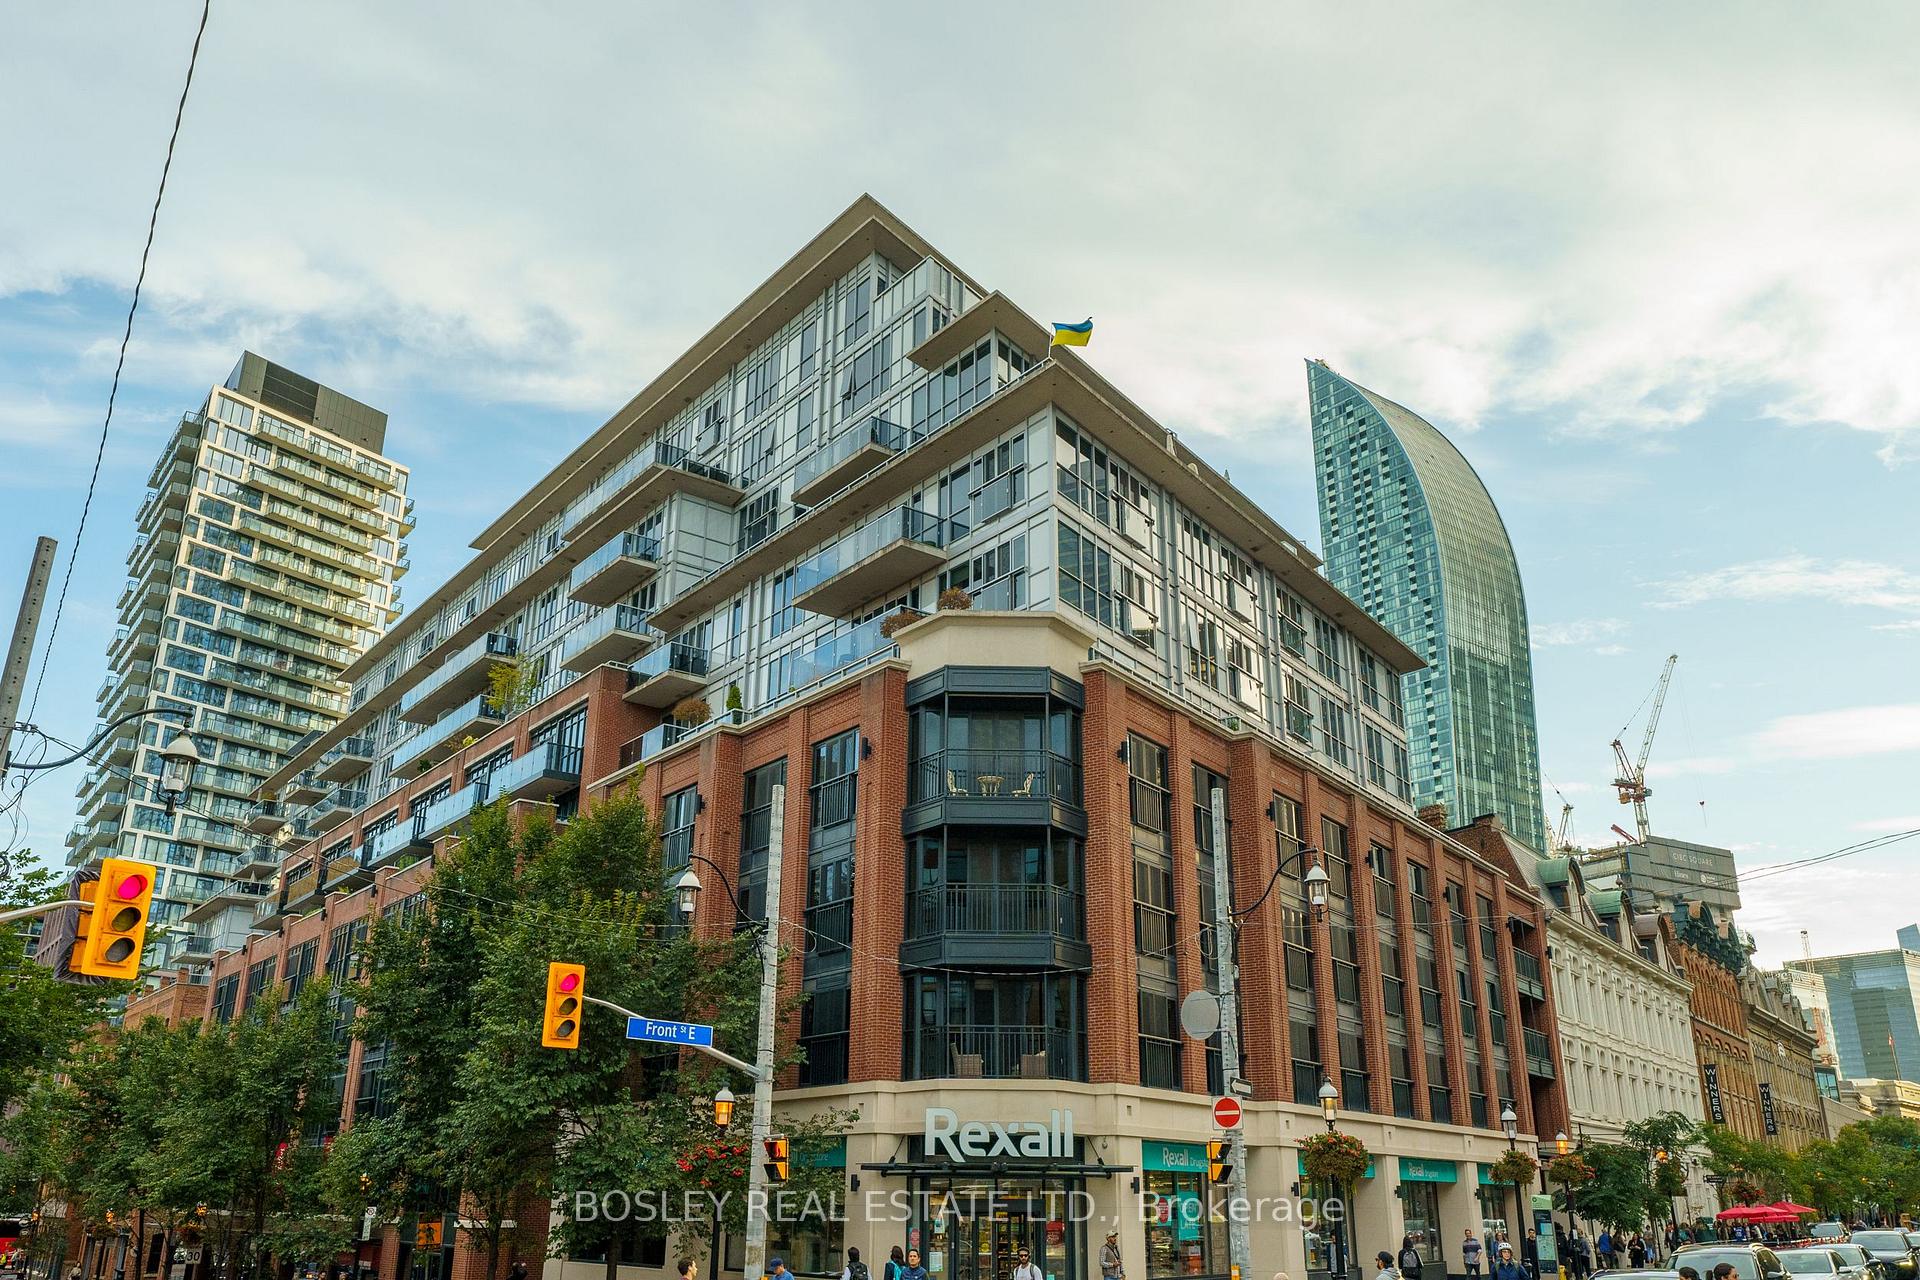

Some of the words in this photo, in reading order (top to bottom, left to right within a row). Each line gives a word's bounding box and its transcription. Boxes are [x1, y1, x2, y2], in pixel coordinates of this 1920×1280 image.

[646, 1021, 677, 1038] Front
[680, 1025, 687, 1033] St
[688, 1026, 696, 1040] E
[1705, 1068, 1722, 1120] WINNERS
[1760, 1086, 1775, 1132] WINNERS
[924, 1106, 1074, 1163] Rexall
[1162, 1147, 1189, 1167] Rexall
[186, 1251, 200, 1261] 30
